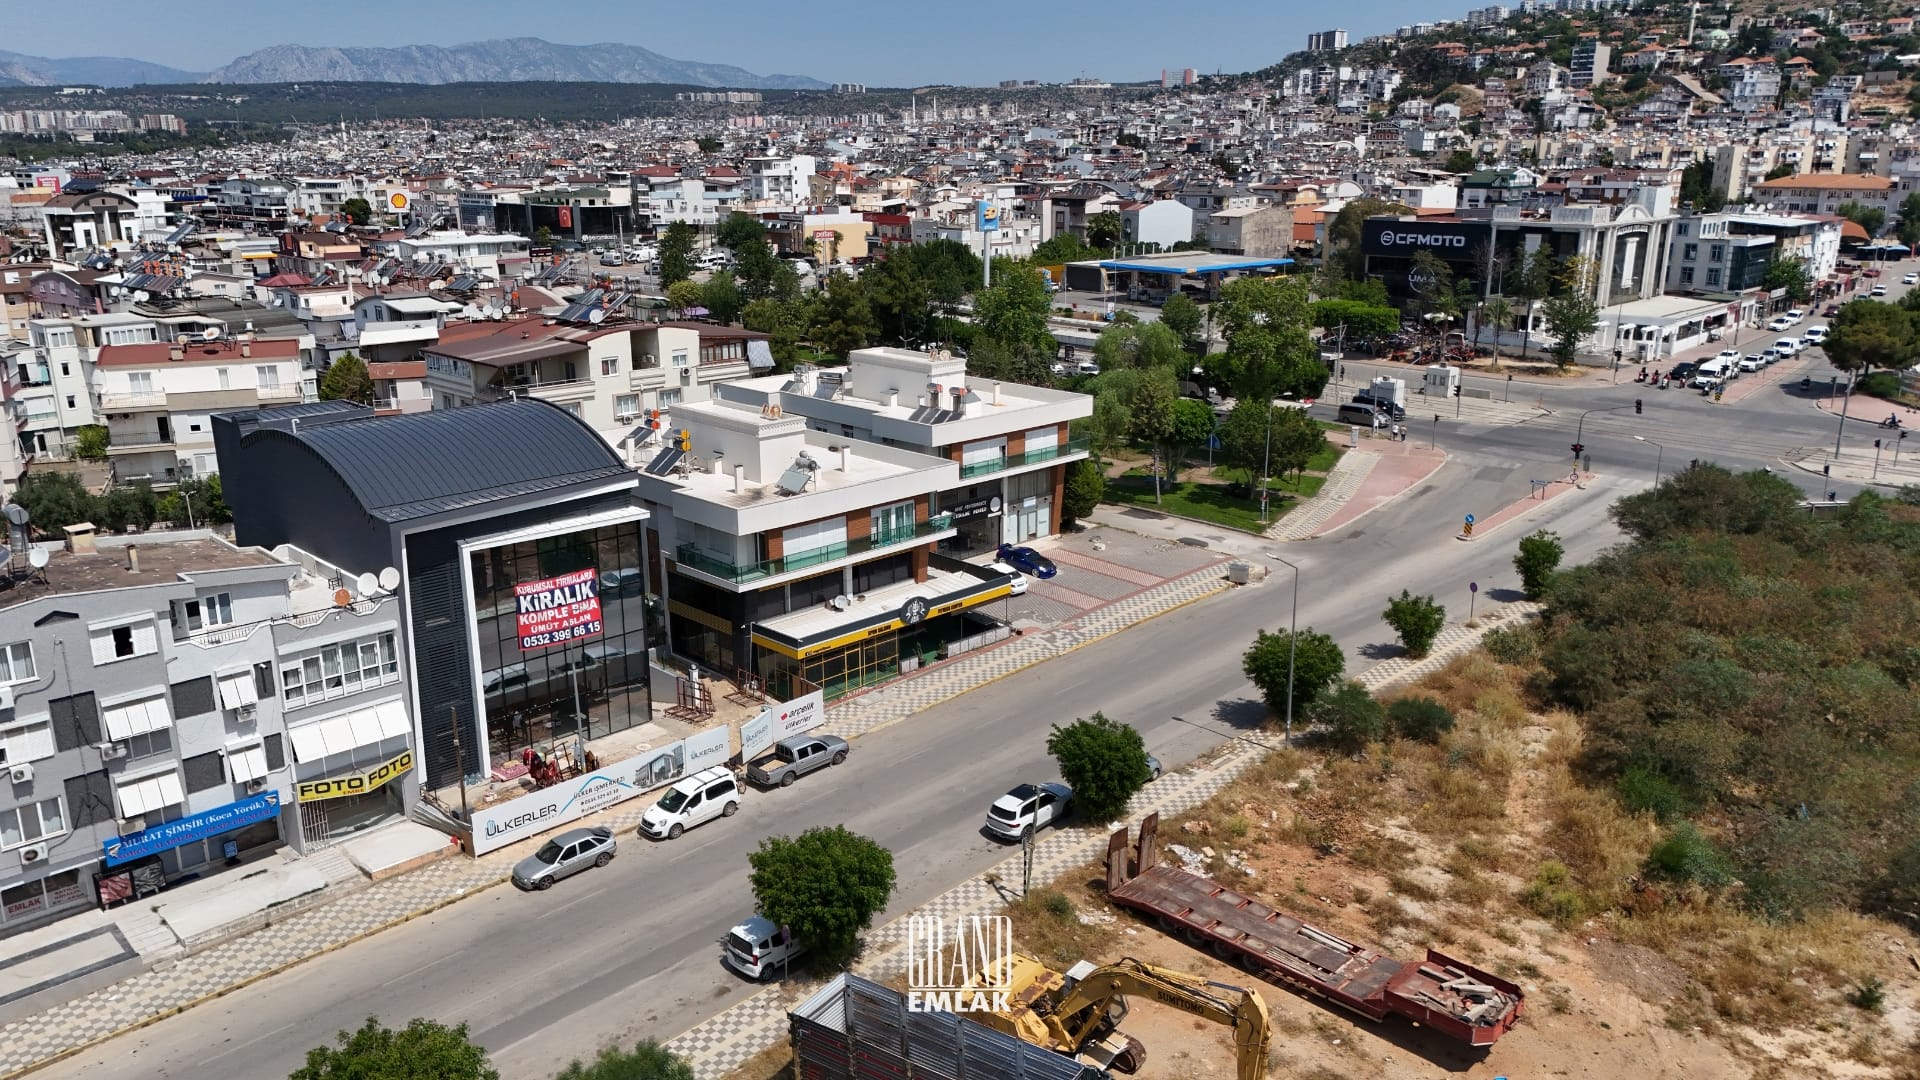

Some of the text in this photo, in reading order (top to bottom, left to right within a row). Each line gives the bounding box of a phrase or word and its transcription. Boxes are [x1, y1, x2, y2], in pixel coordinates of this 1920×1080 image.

[1396, 233, 1465, 247] CFMOTO
[517, 580, 555, 594] KURUMSAL
[520, 606, 568, 625] KOMPLE
[562, 614, 591, 628] ASLAN
[523, 621, 600, 647] 0532 399 66 15
[369, 753, 411, 784] FOTO
[300, 777, 364, 796] FOTO
[121, 801, 265, 848] MURAT ŞİMŞİR (Koca Yörük)
[8, 898, 41, 914] EMLAK
[1157, 990, 1205, 1015] SUMITOMO
